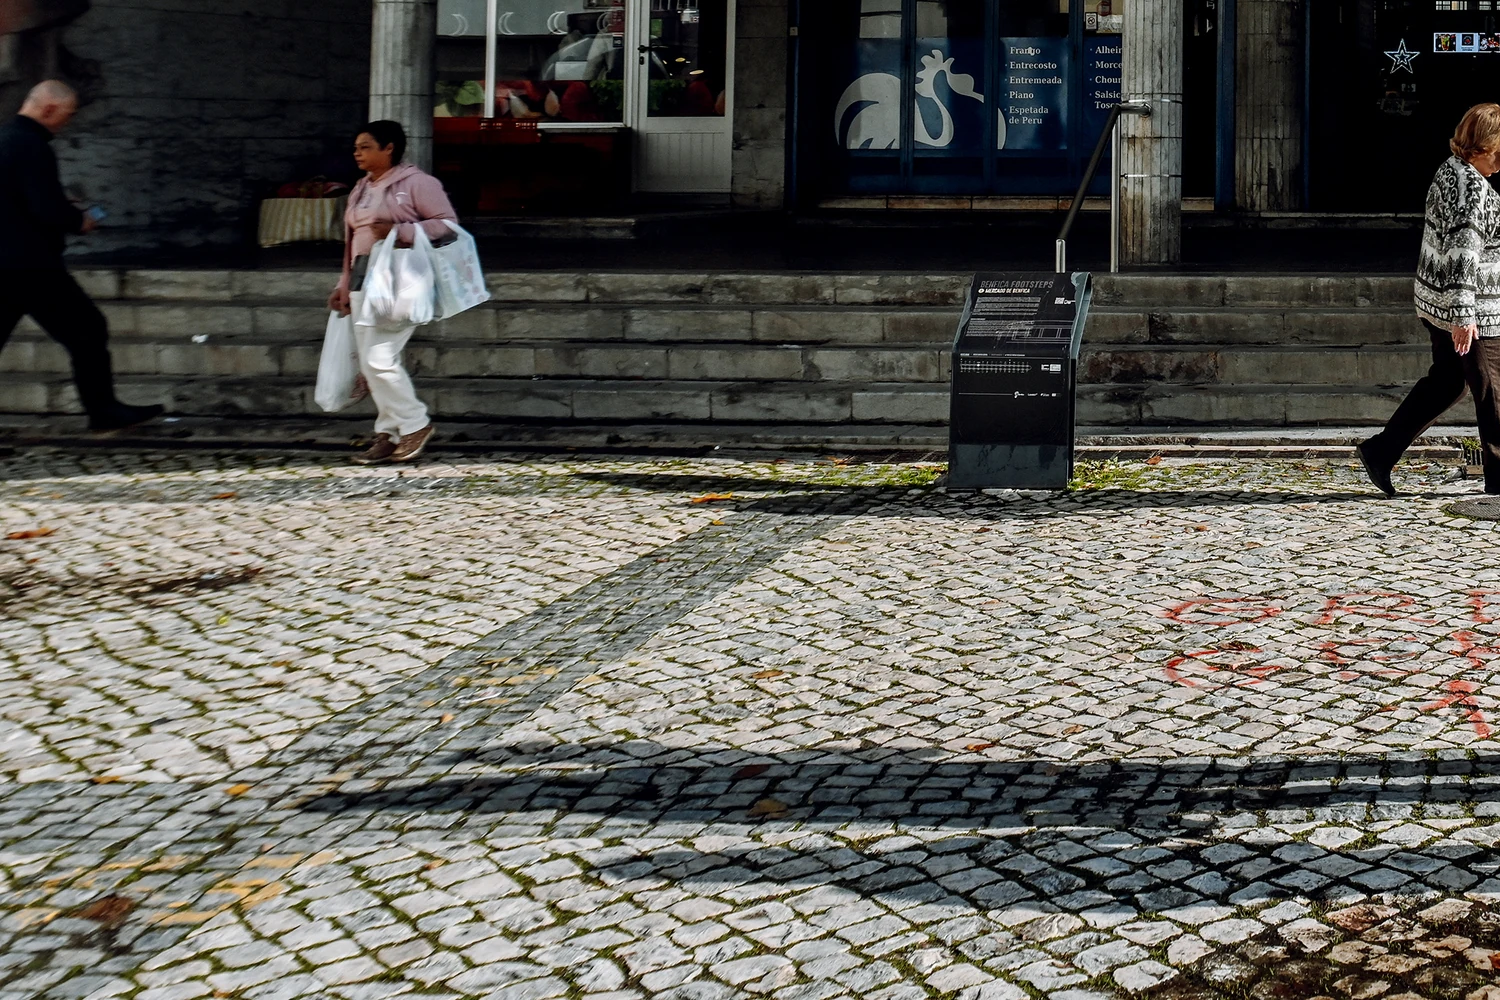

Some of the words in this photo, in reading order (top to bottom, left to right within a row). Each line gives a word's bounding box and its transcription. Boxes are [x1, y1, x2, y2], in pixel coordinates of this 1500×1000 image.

[1010, 46, 1041, 56] Frango
[1010, 62, 1057, 70] Entrecosto
[1009, 76, 1062, 84] Entremeada
[1009, 91, 1034, 99] Piano
[1009, 106, 1049, 115] Espetada
[1022, 116, 1043, 124] Peru
[980, 280, 1009, 288] BENFICA
[1010, 281, 1054, 289] FOOTSTEPS
